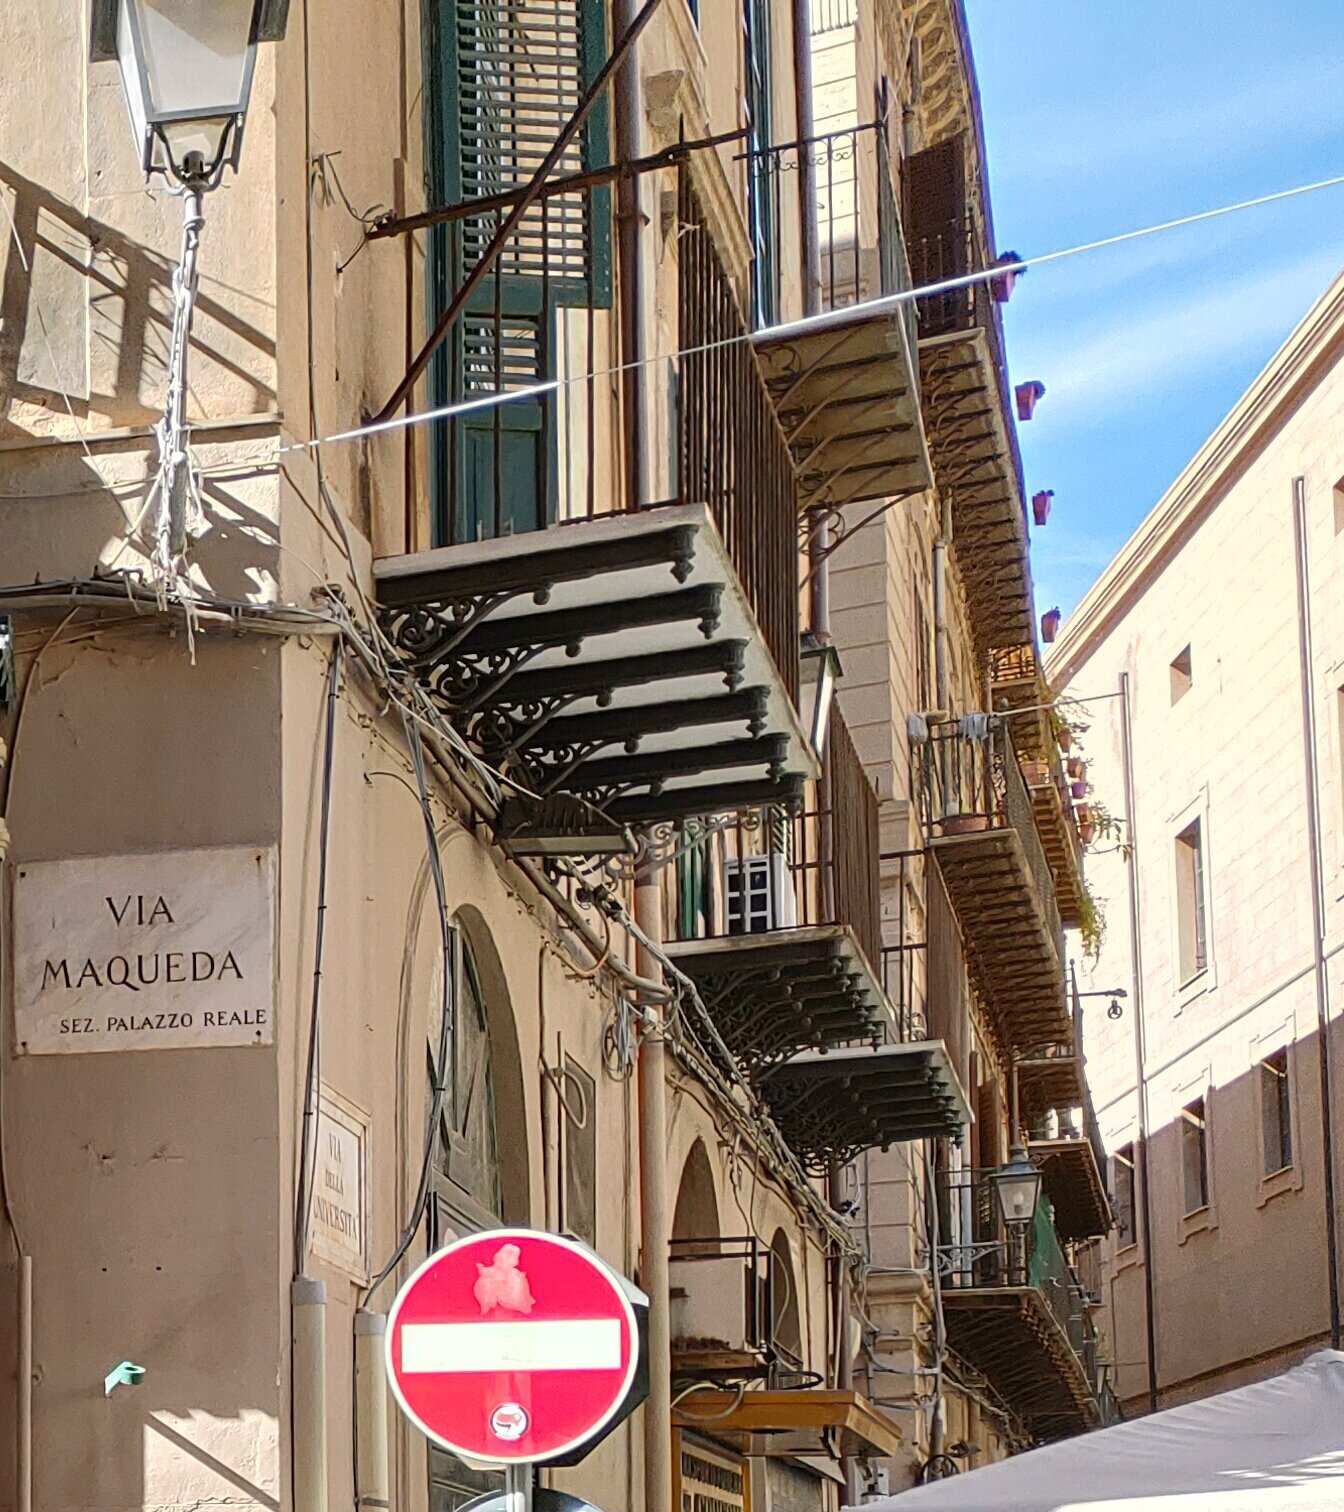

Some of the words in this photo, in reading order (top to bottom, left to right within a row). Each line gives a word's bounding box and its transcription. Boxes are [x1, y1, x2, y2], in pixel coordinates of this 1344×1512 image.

[106, 895, 175, 926] VIA
[41, 950, 244, 992] MAQUEDA
[60, 1018, 100, 1034] SEZ.
[107, 1012, 194, 1032] PALAZZO
[203, 1008, 268, 1028] REALE
[328, 1132, 342, 1164] VIA
[325, 1167, 344, 1197] DELLA
